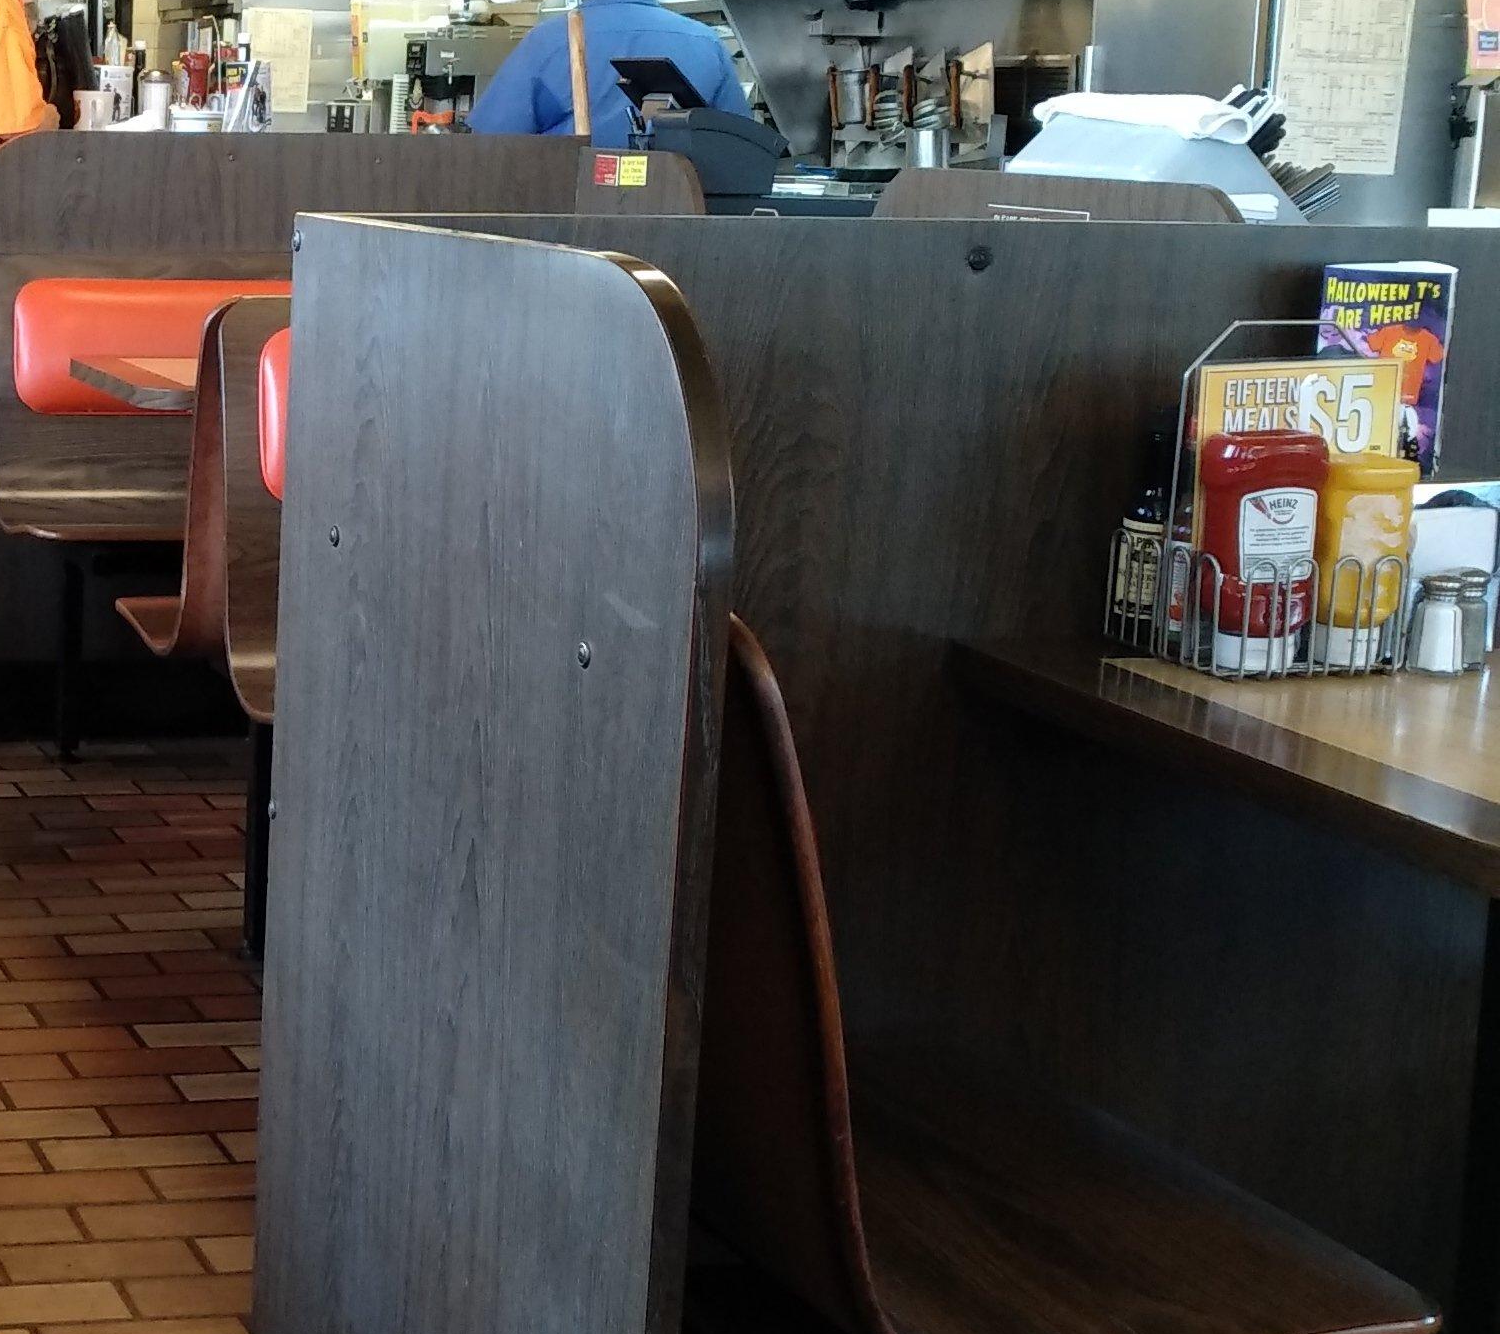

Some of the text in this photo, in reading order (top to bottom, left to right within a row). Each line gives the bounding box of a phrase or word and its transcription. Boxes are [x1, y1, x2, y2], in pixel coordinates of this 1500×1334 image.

[1326, 276, 1411, 304] HALLOWEEN
[1335, 301, 1421, 330] ARE HERE!
[1223, 405, 1300, 433] MEALS
[1225, 373, 1375, 454] FIFTEEN $5
[1269, 498, 1299, 510] HEINZ
